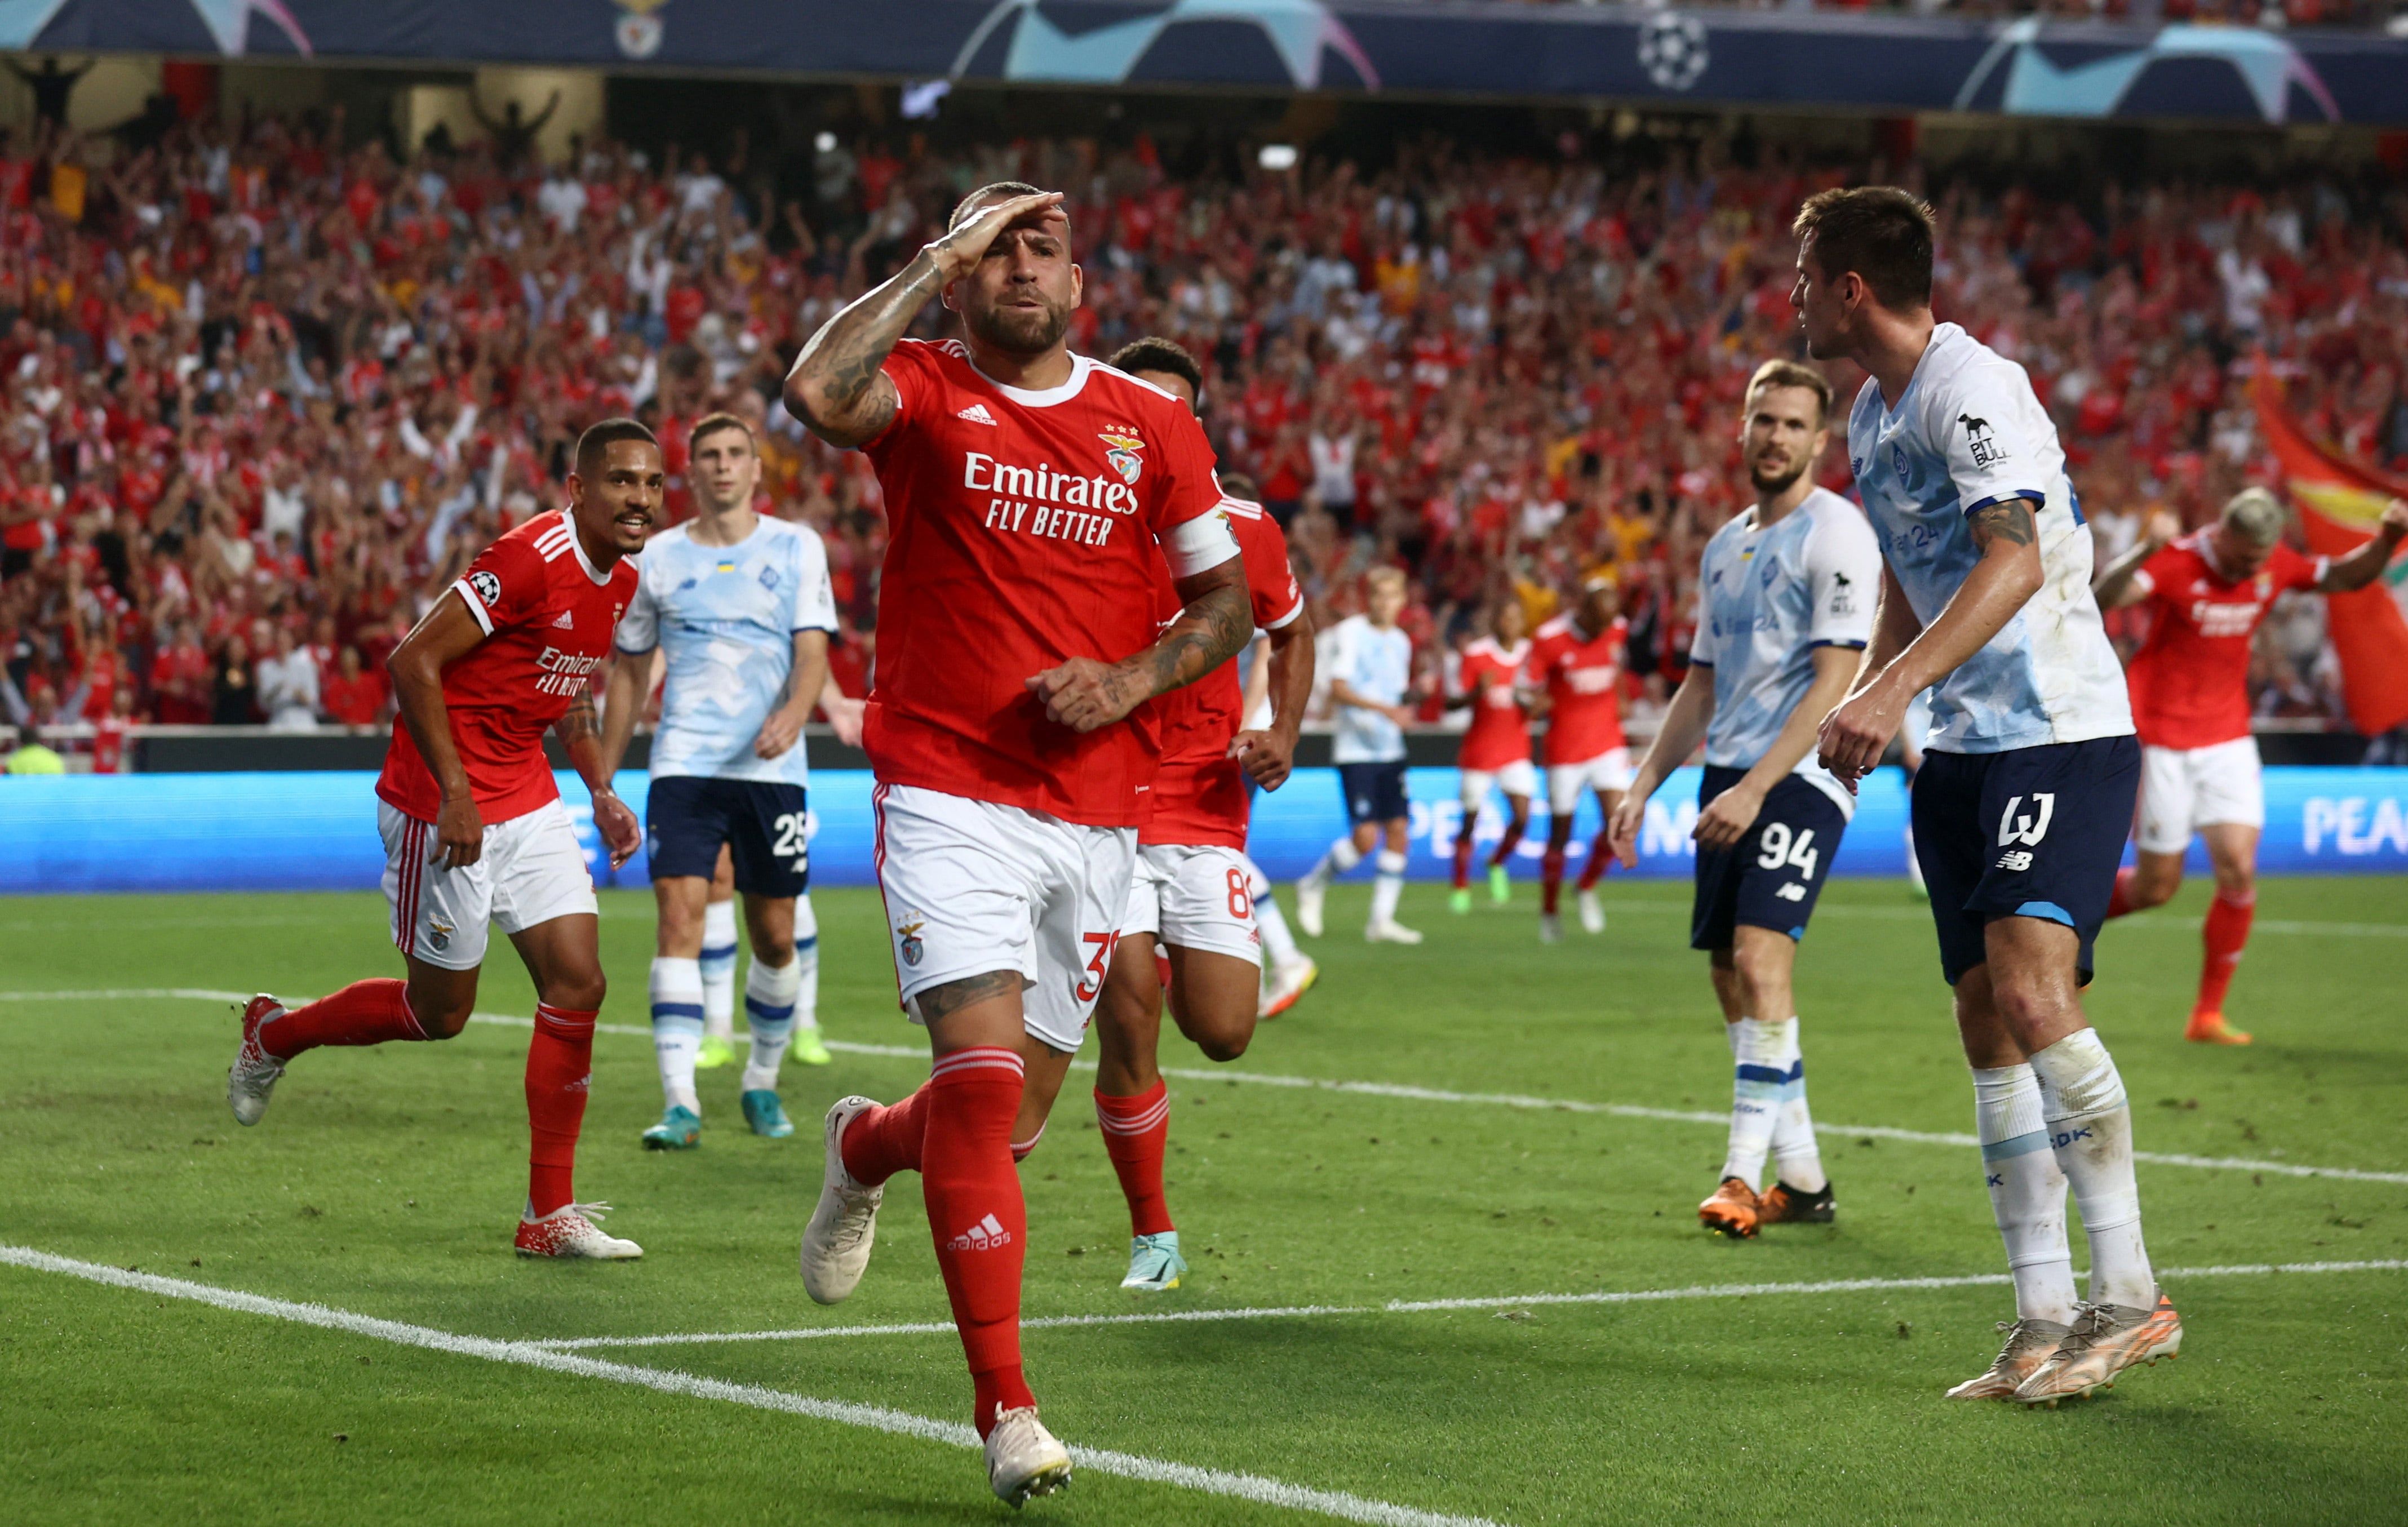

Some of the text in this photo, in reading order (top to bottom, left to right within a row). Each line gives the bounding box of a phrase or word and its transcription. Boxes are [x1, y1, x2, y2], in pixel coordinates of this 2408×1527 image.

[1970, 437, 1992, 455] PIT
[1974, 448, 2011, 467] BULL
[964, 451, 1138, 515] Emirates
[985, 499, 1114, 547] FLY BETTER
[536, 645, 601, 675] Emirat
[2302, 796, 2408, 854] PEA
[1758, 822, 1818, 881] 94
[947, 1232, 1011, 1250] adidas
